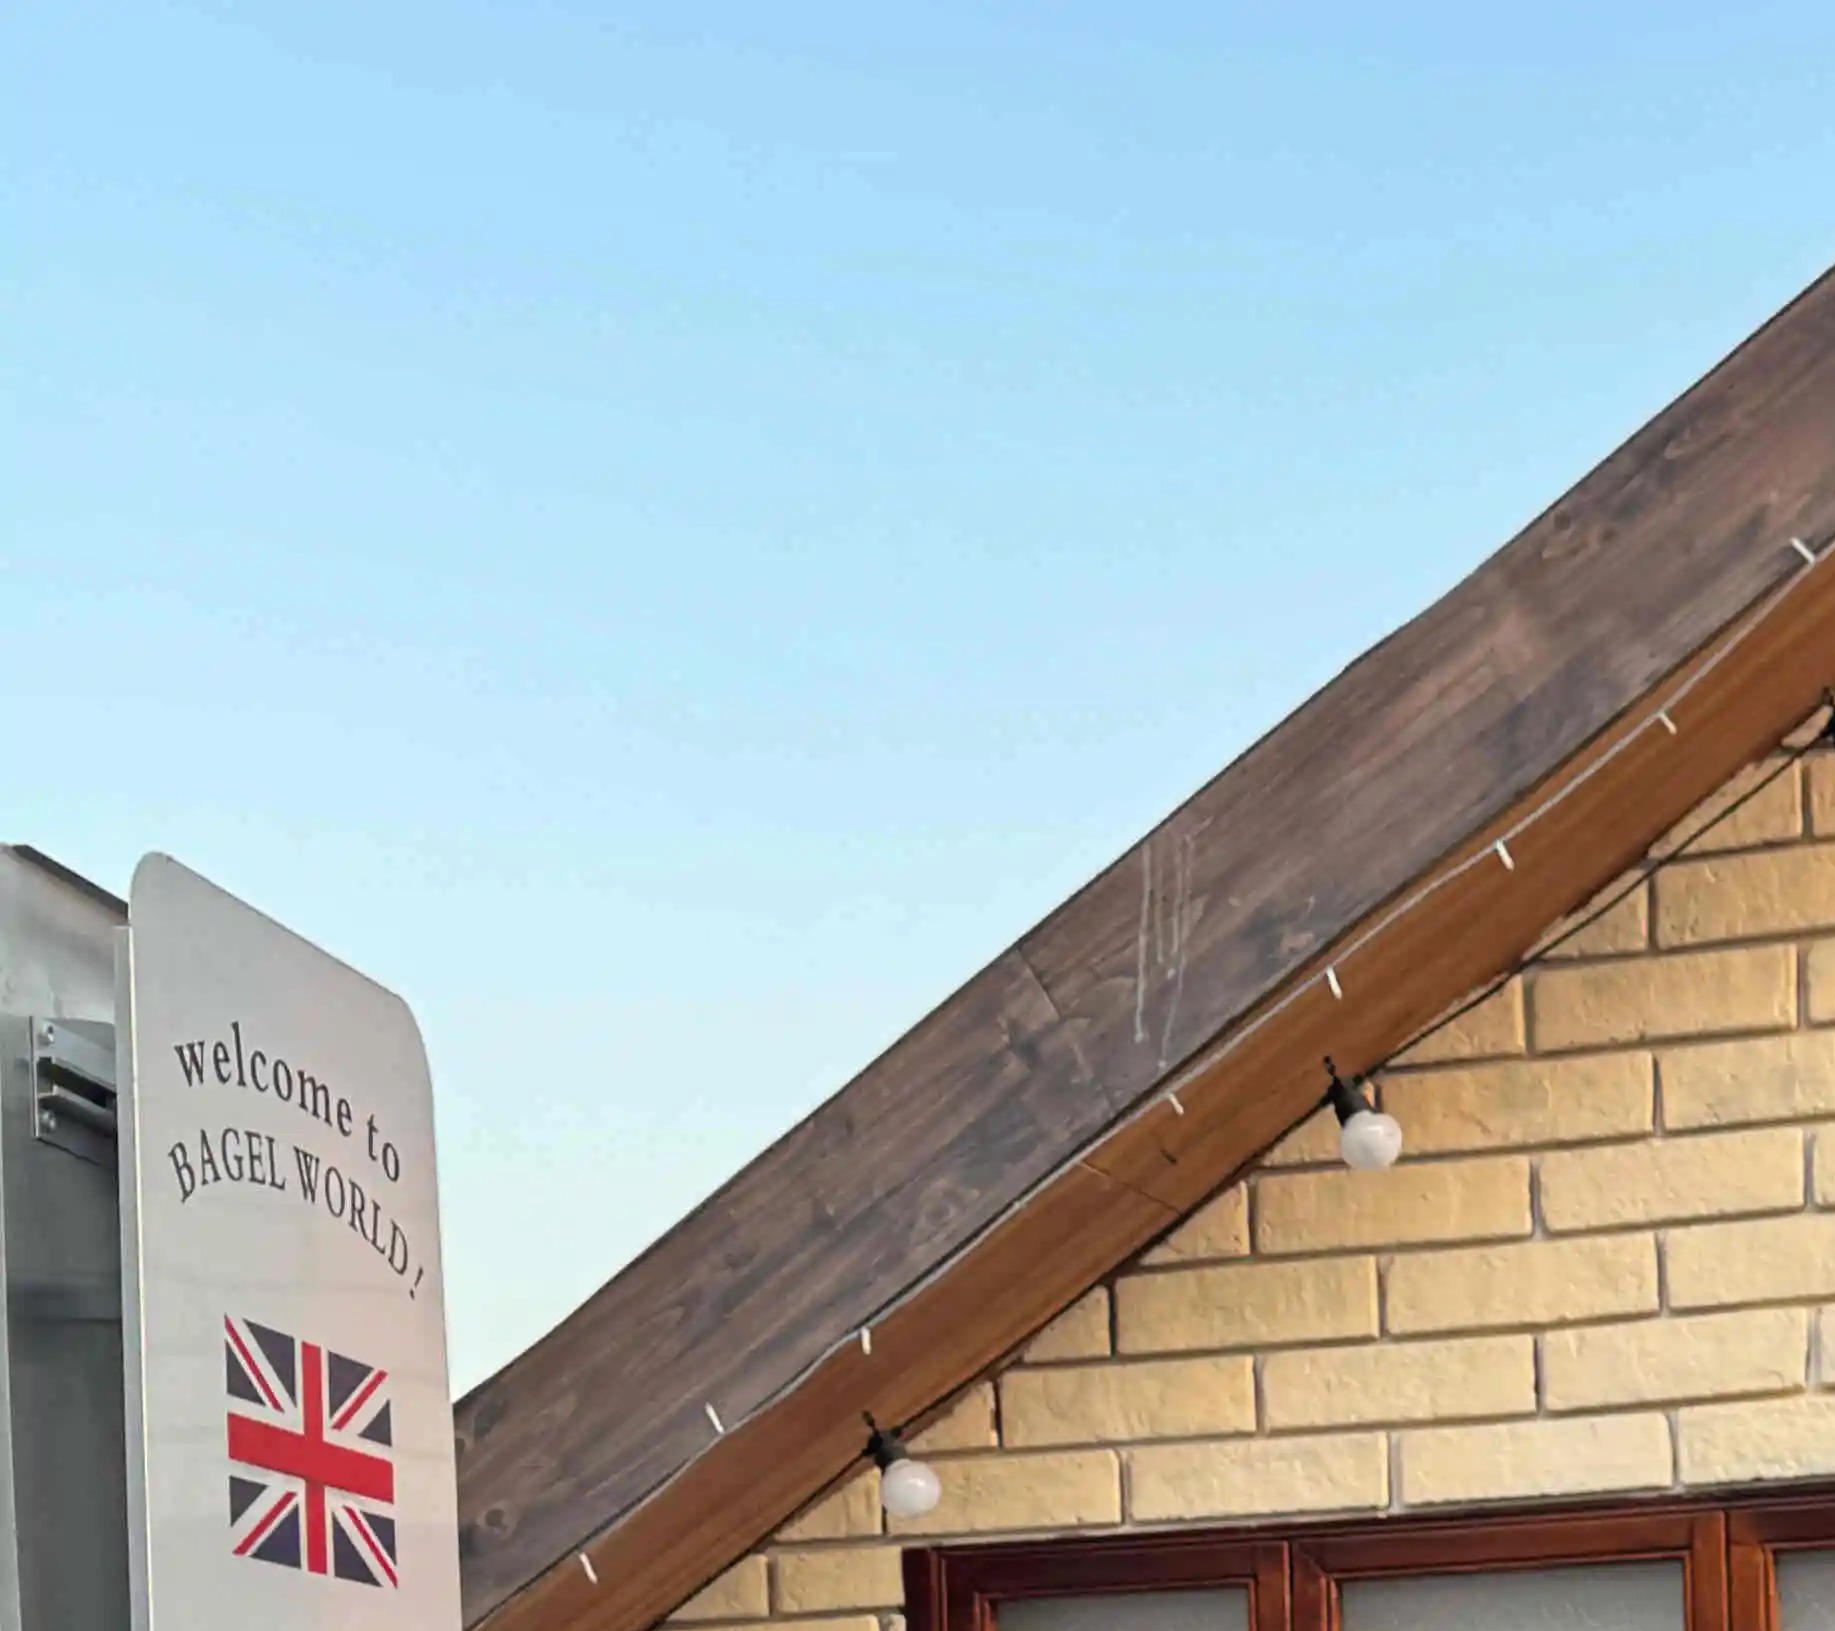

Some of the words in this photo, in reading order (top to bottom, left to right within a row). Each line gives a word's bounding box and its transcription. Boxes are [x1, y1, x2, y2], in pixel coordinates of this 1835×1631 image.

[174, 1021, 353, 1137] welcome
[367, 1114, 401, 1183] to
[168, 1128, 287, 1204] BAGEL
[293, 1145, 425, 1300] WORLD!
